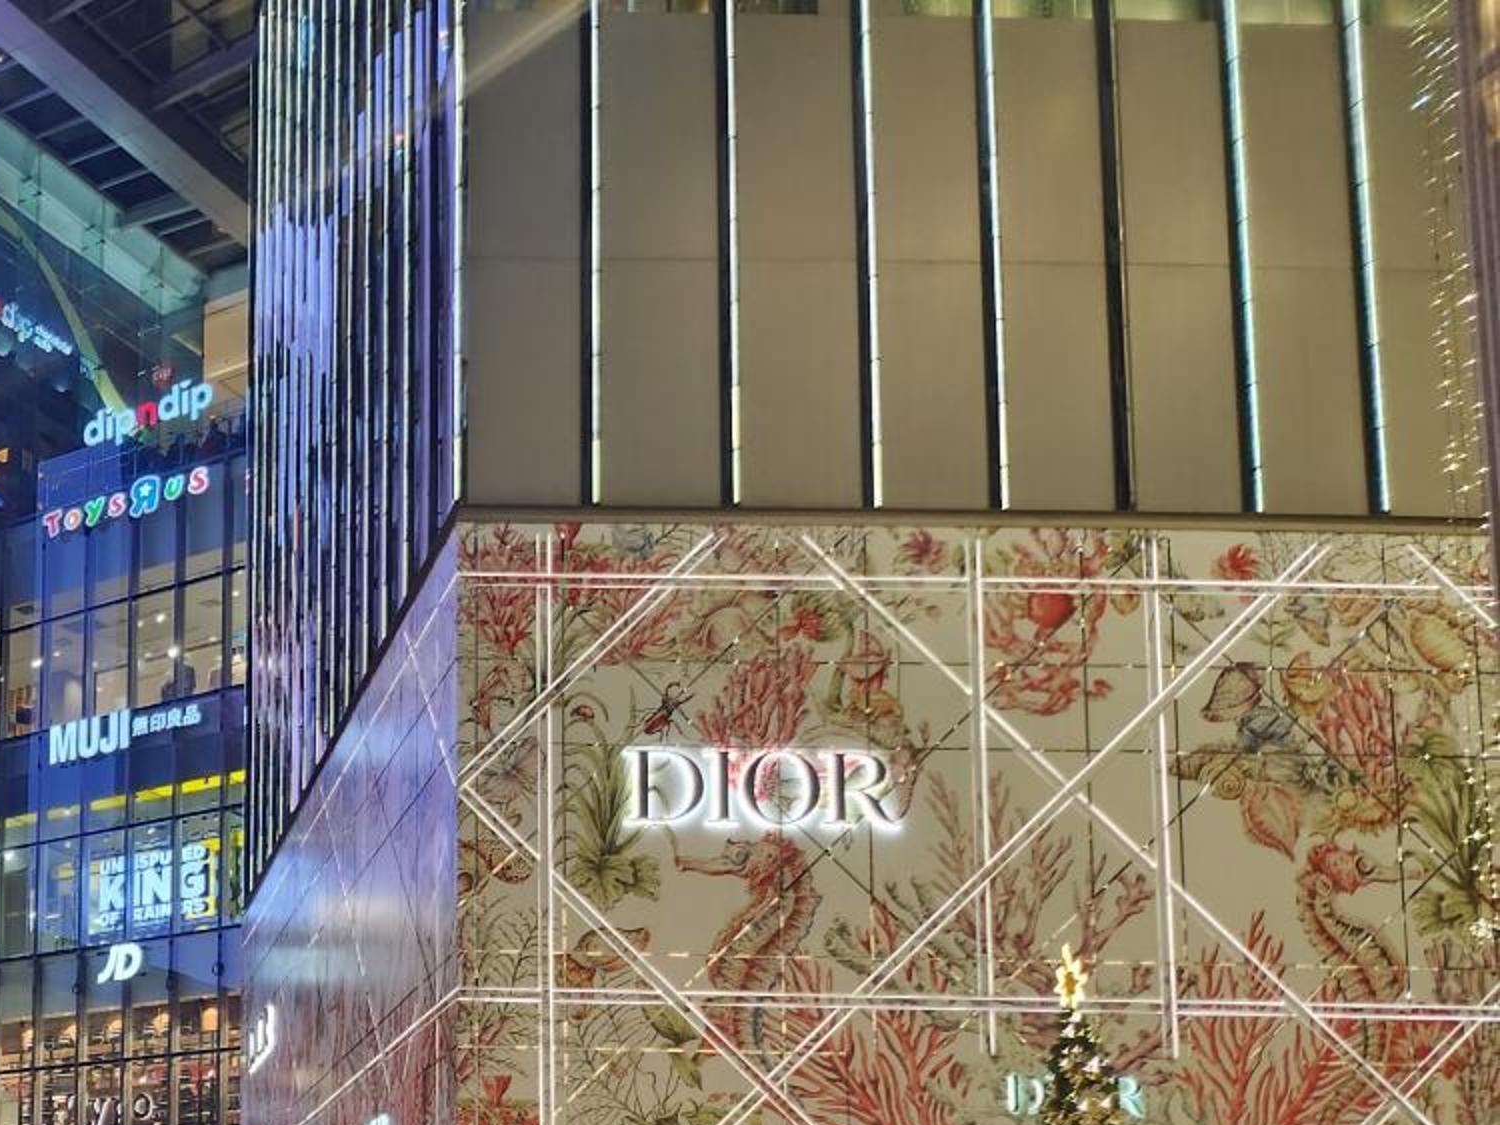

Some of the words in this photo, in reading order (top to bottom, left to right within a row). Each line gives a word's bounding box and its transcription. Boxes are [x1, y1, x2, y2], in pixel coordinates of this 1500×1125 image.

[84, 379, 213, 447] dipndip
[49, 708, 132, 766] MUJI
[622, 745, 904, 830] DIOR
[100, 862, 206, 911] KING
[97, 943, 143, 984] JD
[1006, 1072, 1146, 1119] DR
